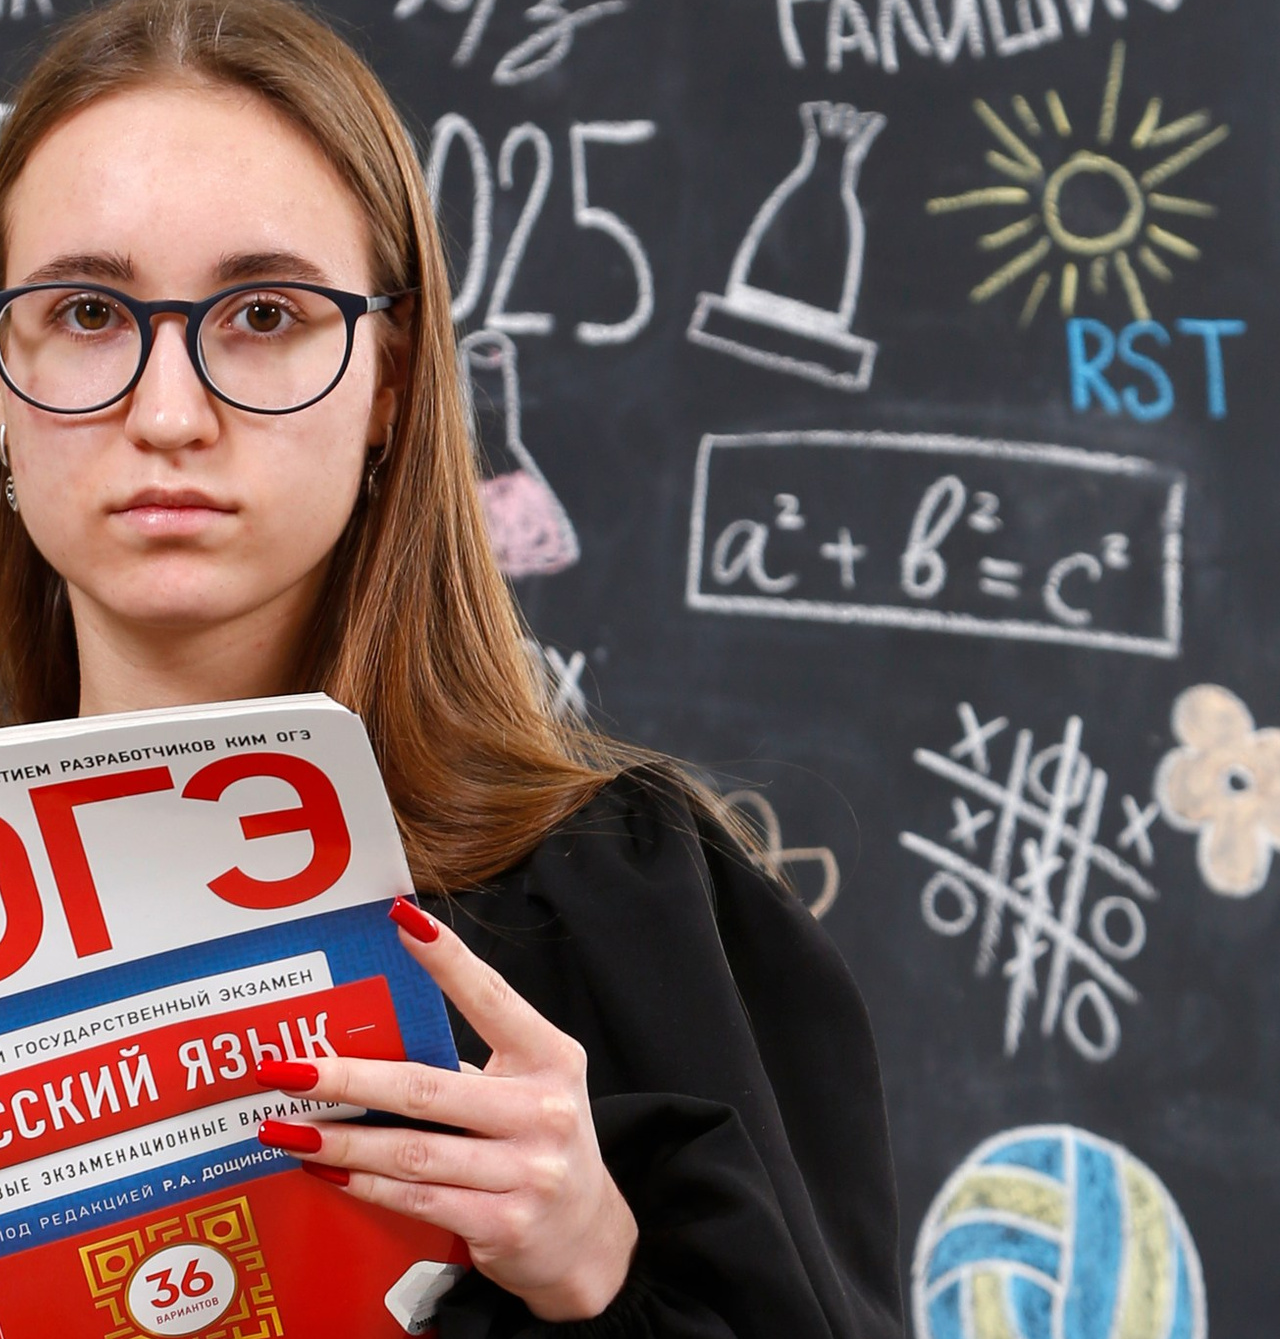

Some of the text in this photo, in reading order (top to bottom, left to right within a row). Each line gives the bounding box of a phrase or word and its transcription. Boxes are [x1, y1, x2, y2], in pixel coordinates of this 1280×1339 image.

[1063, 316, 1247, 423] RST
[60, 739, 216, 773] РАЗРАБОТЧИКОВ
[225, 733, 268, 749] КИМ
[276, 729, 312, 743] ОГЭ
[14, 989, 212, 1060] ГОСУДАРСТВЕННЫЙ
[218, 969, 315, 1003] ЭКЗАМЕН
[40, 1116, 229, 1187] ЭКЗАМЕНАЦИОННЫЕ
[39, 1183, 154, 1230] РЕДАКЦИЕЙ
[201, 1146, 291, 1184] ДОЩИНСК
[145, 1257, 214, 1309] 36
[156, 1296, 220, 1325] ВАРИАНТОВ
